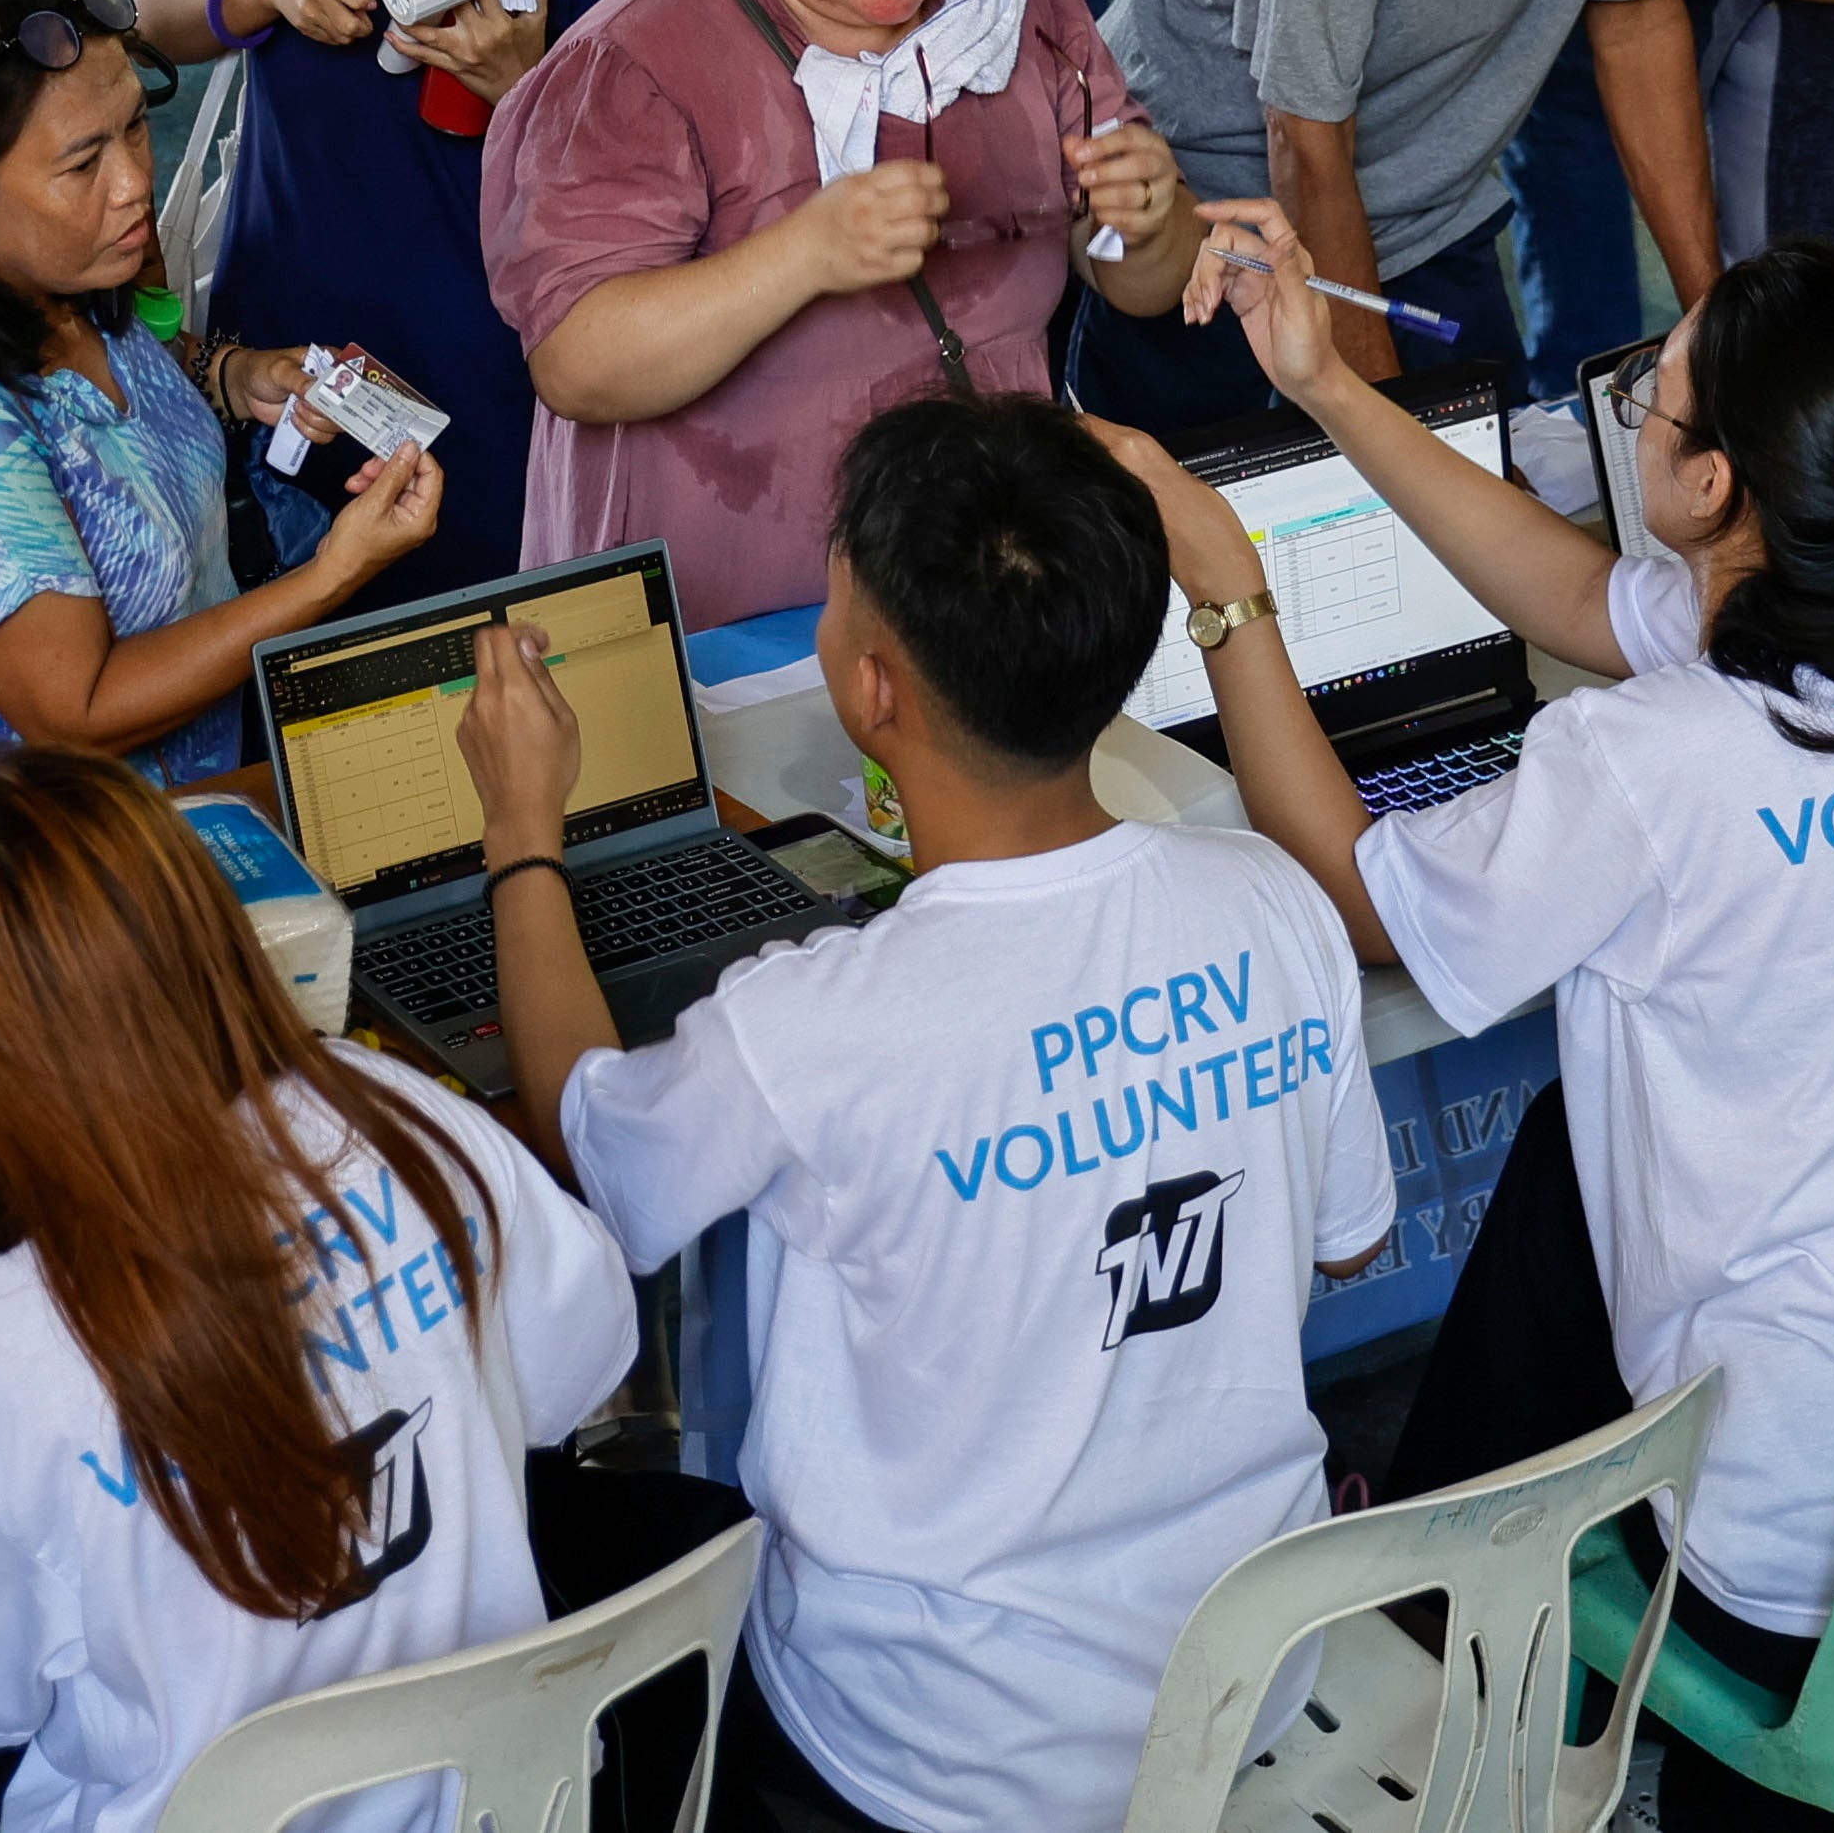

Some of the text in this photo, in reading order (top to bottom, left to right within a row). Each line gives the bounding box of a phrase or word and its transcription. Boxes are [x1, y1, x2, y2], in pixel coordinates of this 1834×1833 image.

[237, 852, 265, 880] PAPER
[1030, 949, 1251, 1095] PPCRV
[934, 1018, 1334, 1202] VOLUNTEER
[1095, 1169, 1246, 1352] TNT
